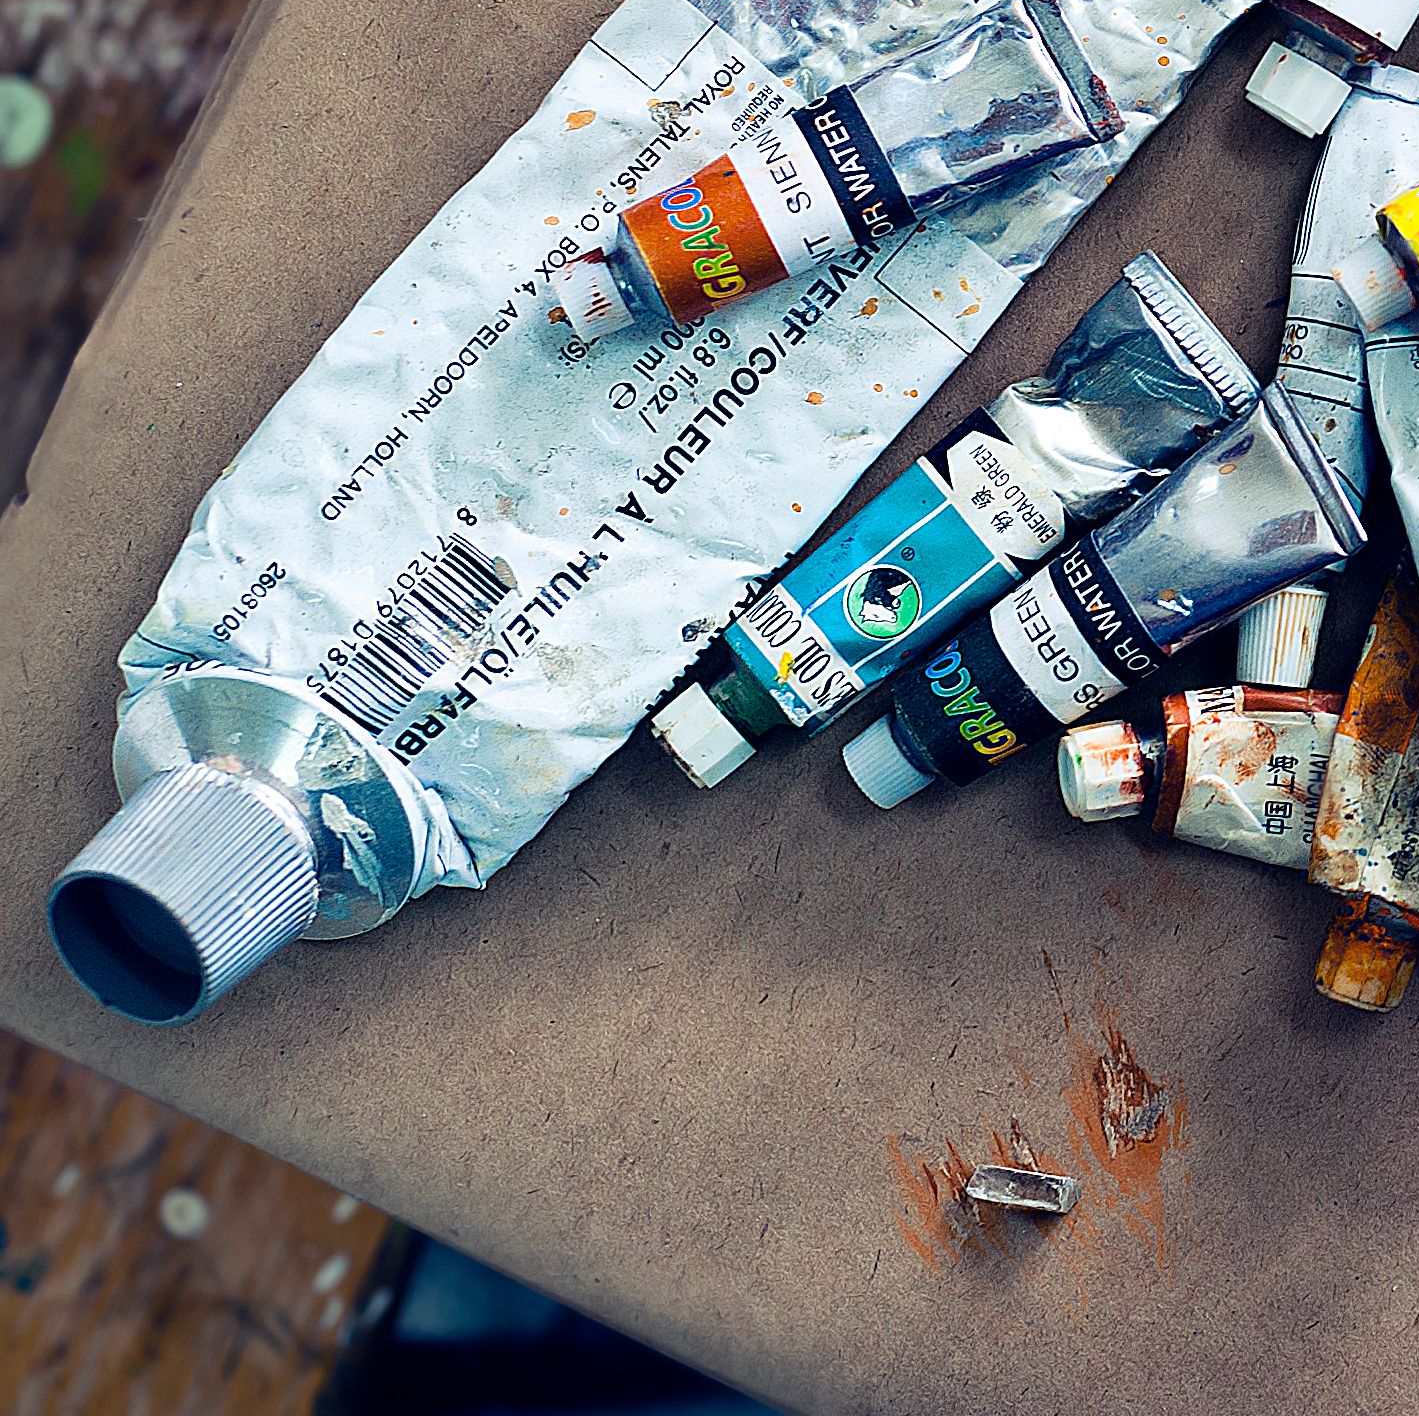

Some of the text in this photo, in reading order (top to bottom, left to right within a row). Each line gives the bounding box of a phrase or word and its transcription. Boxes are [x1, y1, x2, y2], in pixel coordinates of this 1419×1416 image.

[815, 110, 874, 201] WATER
[653, 173, 750, 310] GRACO
[321, 56, 745, 520] ROYAL TALENS, P.O. BOX 4, APELDOORN, HOLLAND
[633, 345, 665, 381] ml
[693, 328, 730, 367] 6.8
[454, 505, 479, 528] 8
[615, 491, 654, 523] À
[970, 445, 1057, 543] EMERALD GREEN
[971, 486, 1013, 533] 粉绿
[377, 536, 453, 618] 712079
[1064, 551, 1122, 640] WATER
[787, 636, 830, 683] OIL
[1014, 588, 1079, 682] GREEN
[1262, 754, 1300, 835] 中国 上海
